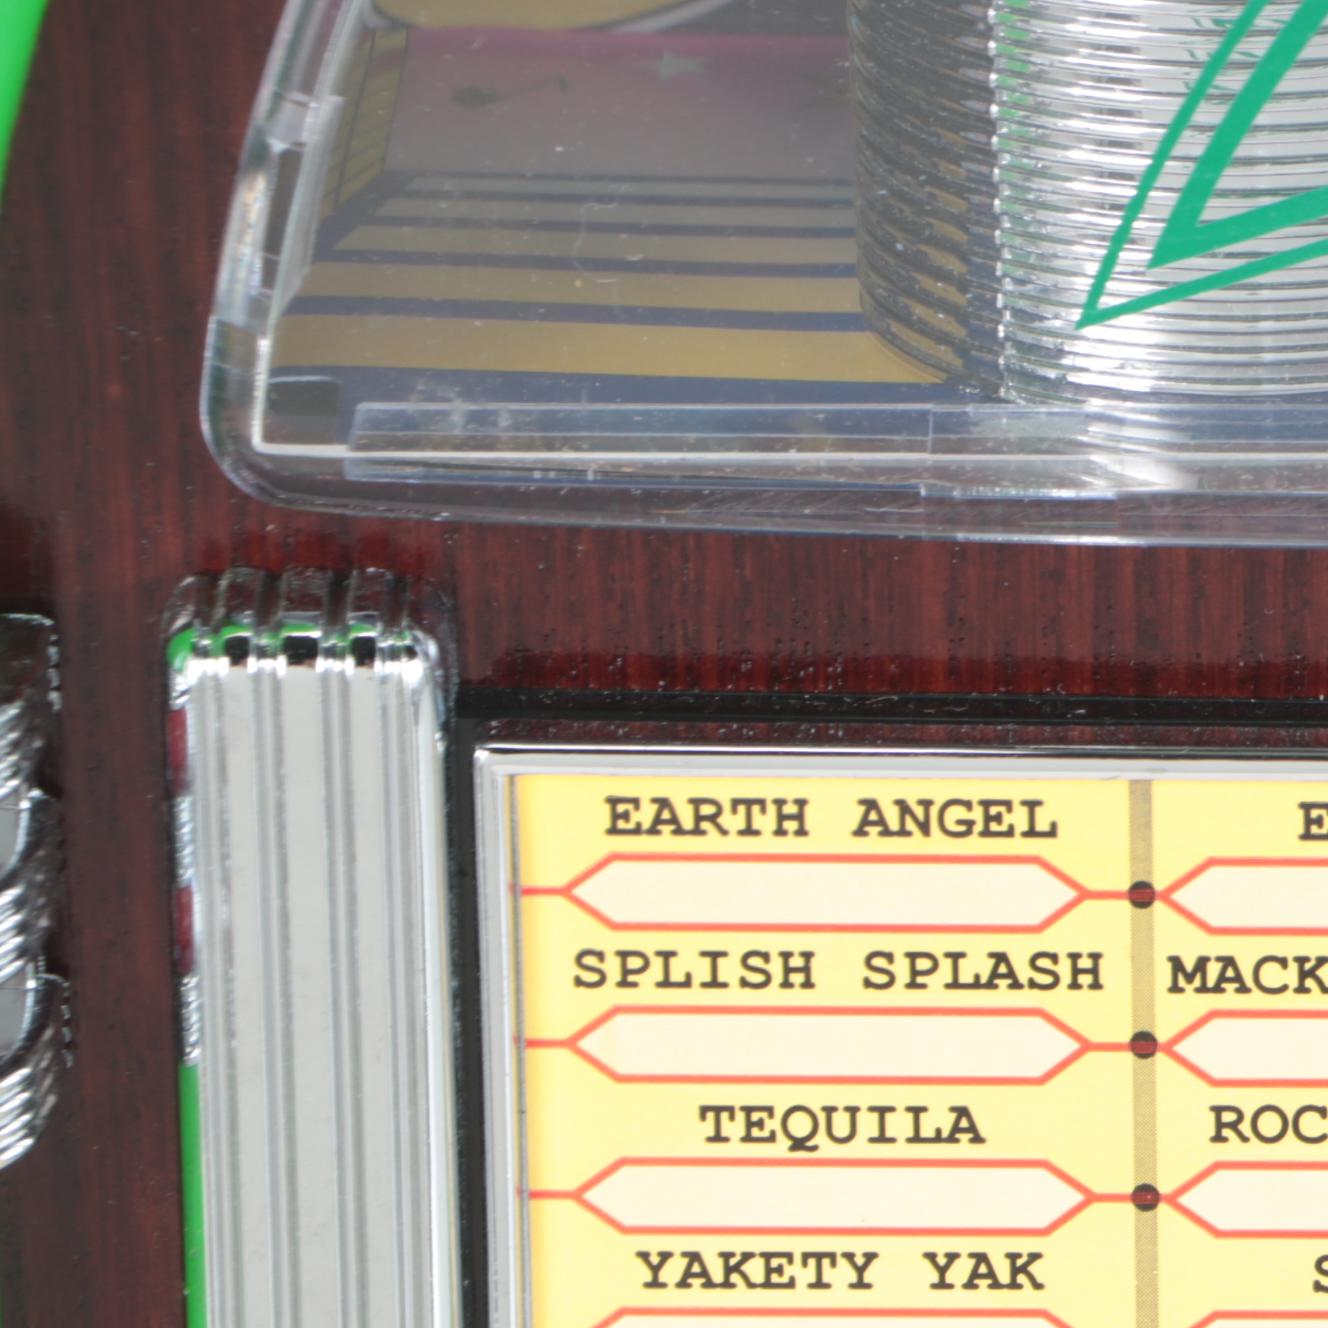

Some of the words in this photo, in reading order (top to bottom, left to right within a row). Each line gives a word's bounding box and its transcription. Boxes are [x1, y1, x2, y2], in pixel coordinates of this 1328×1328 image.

[607, 797, 807, 836] EARTH
[853, 799, 1057, 837] ANGEL
[575, 950, 814, 989] SPLISH
[864, 951, 1102, 990] SPLASH
[700, 1105, 984, 1151] TEQUILA
[638, 1251, 878, 1289] YAKETY
[924, 1252, 1043, 1290] YAK
